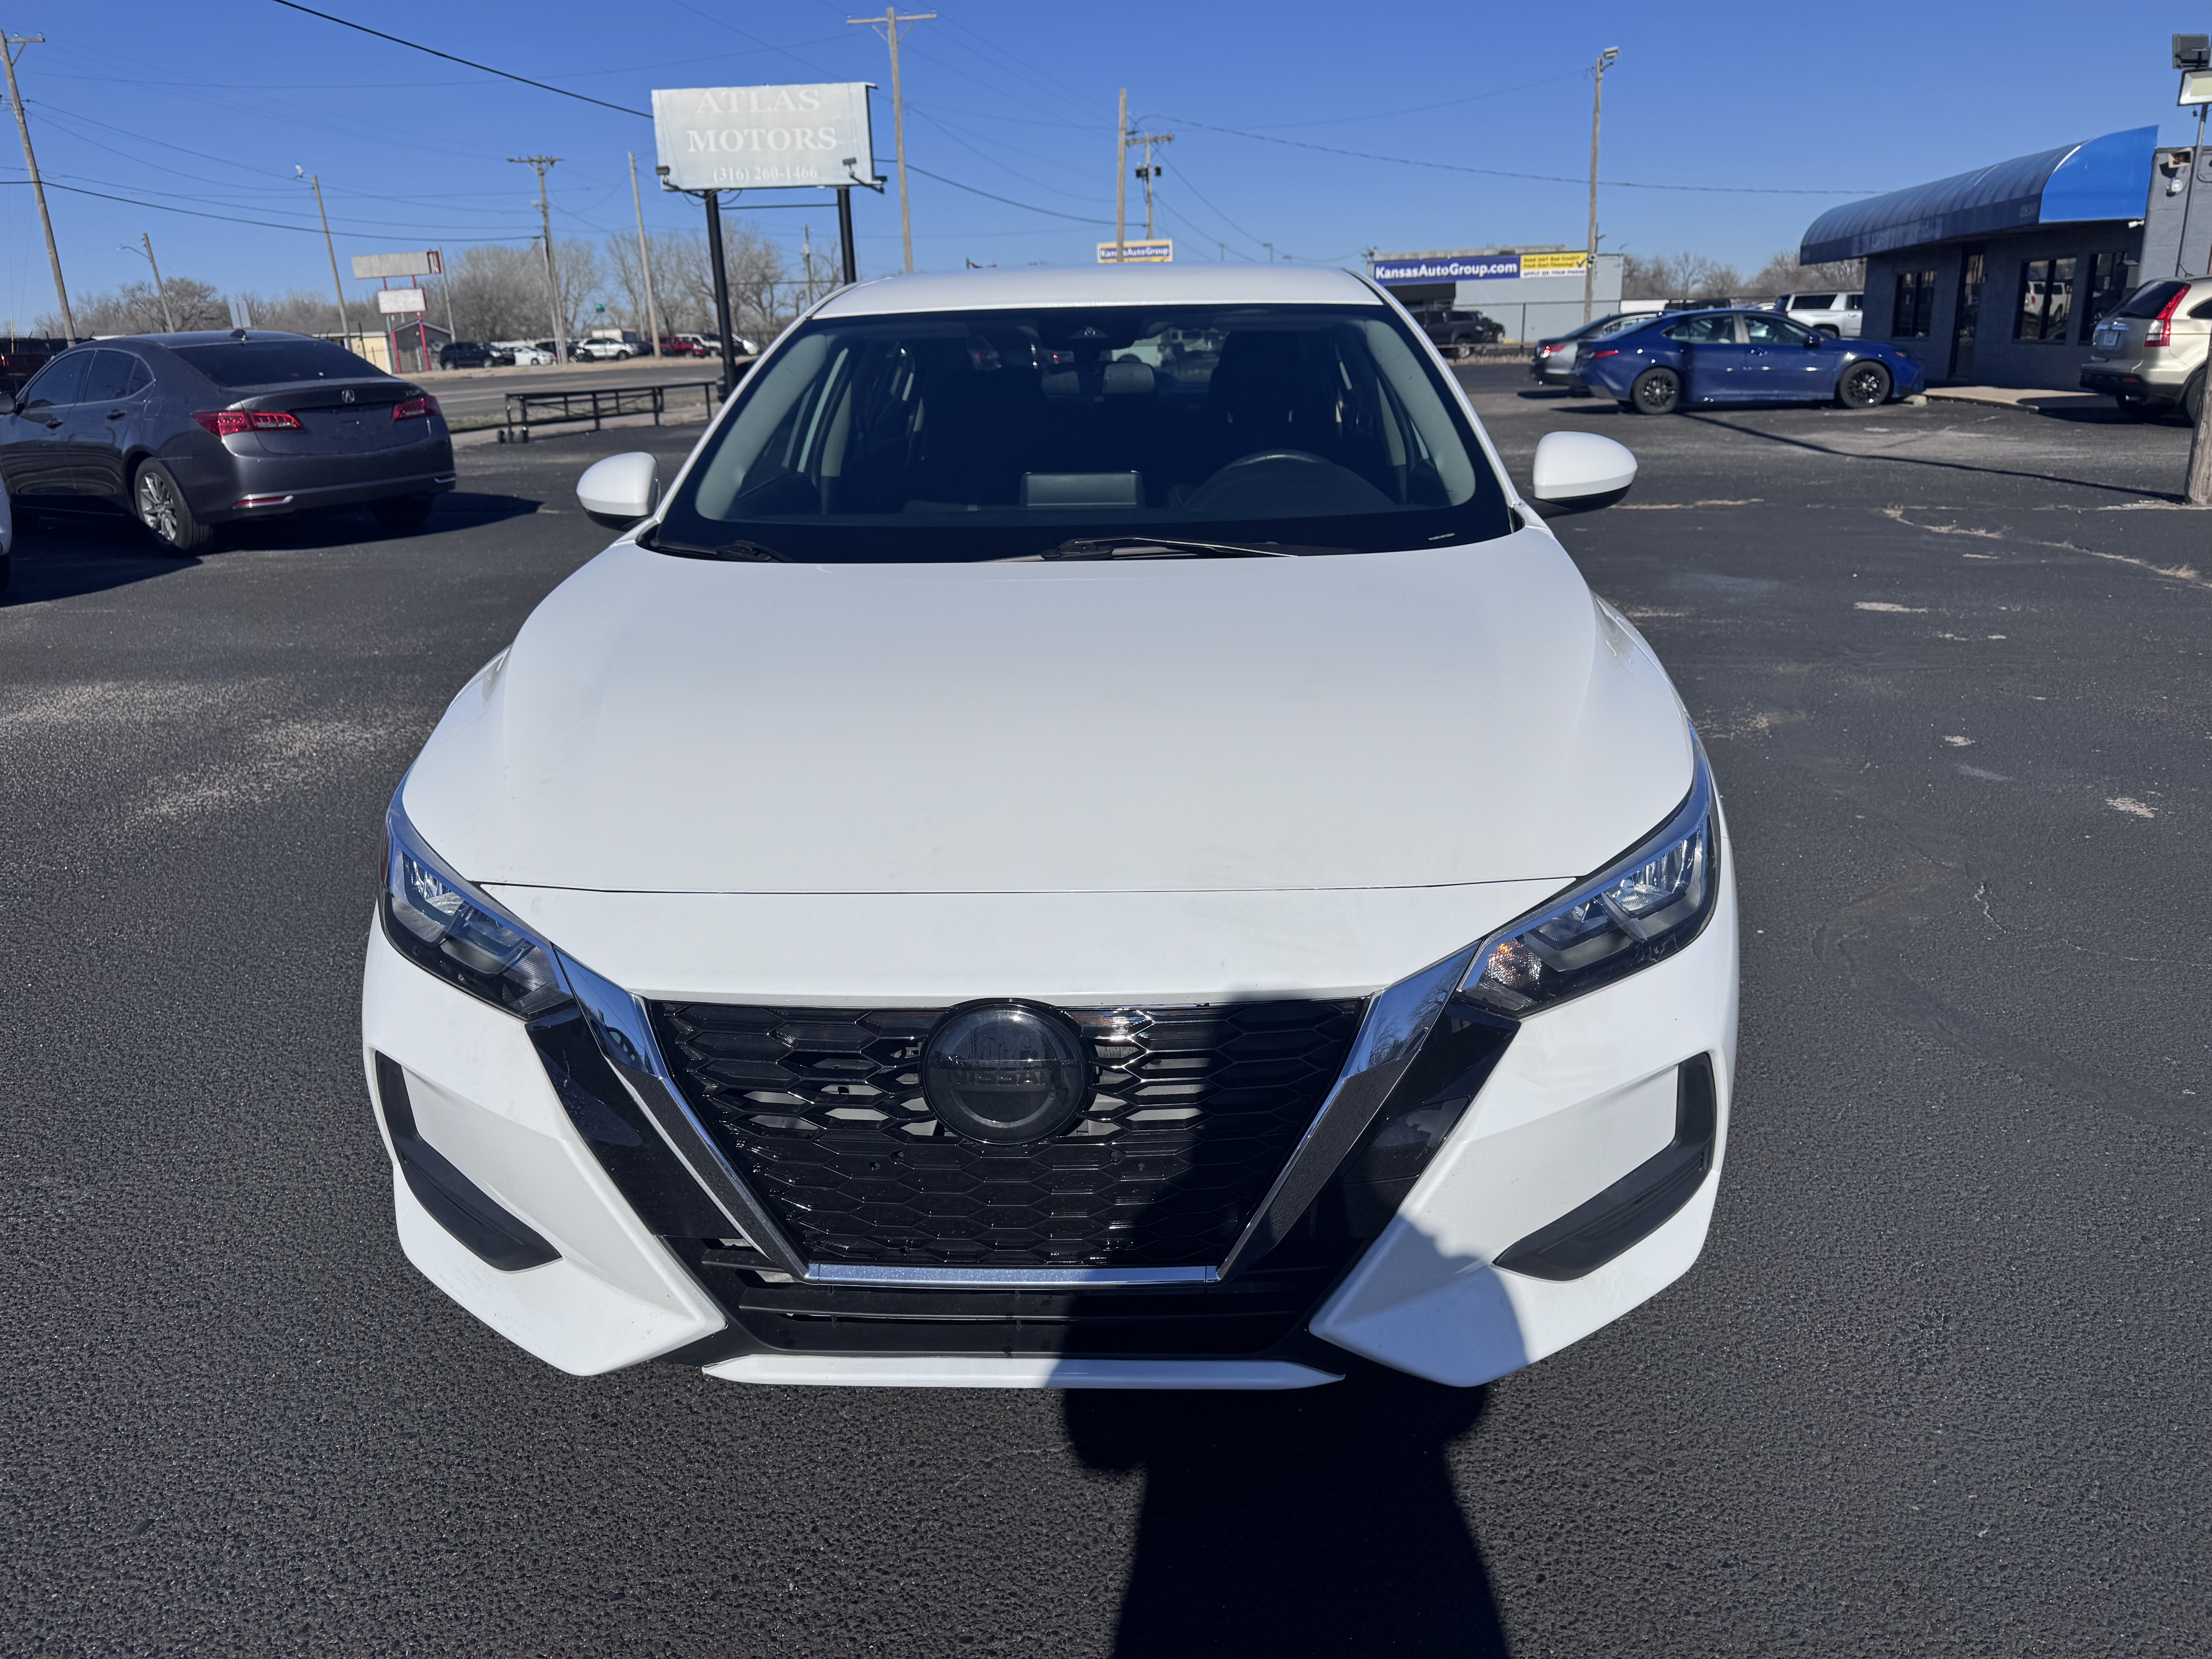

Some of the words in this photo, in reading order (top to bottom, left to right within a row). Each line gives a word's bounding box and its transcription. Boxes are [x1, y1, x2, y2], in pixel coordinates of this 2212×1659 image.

[696, 88, 821, 114] ATLAS
[686, 127, 837, 153] MOTORS
[713, 167, 749, 184] (316)
[755, 166, 818, 180] 260-1466
[1376, 262, 1518, 280] KansasAutoGroup.com
